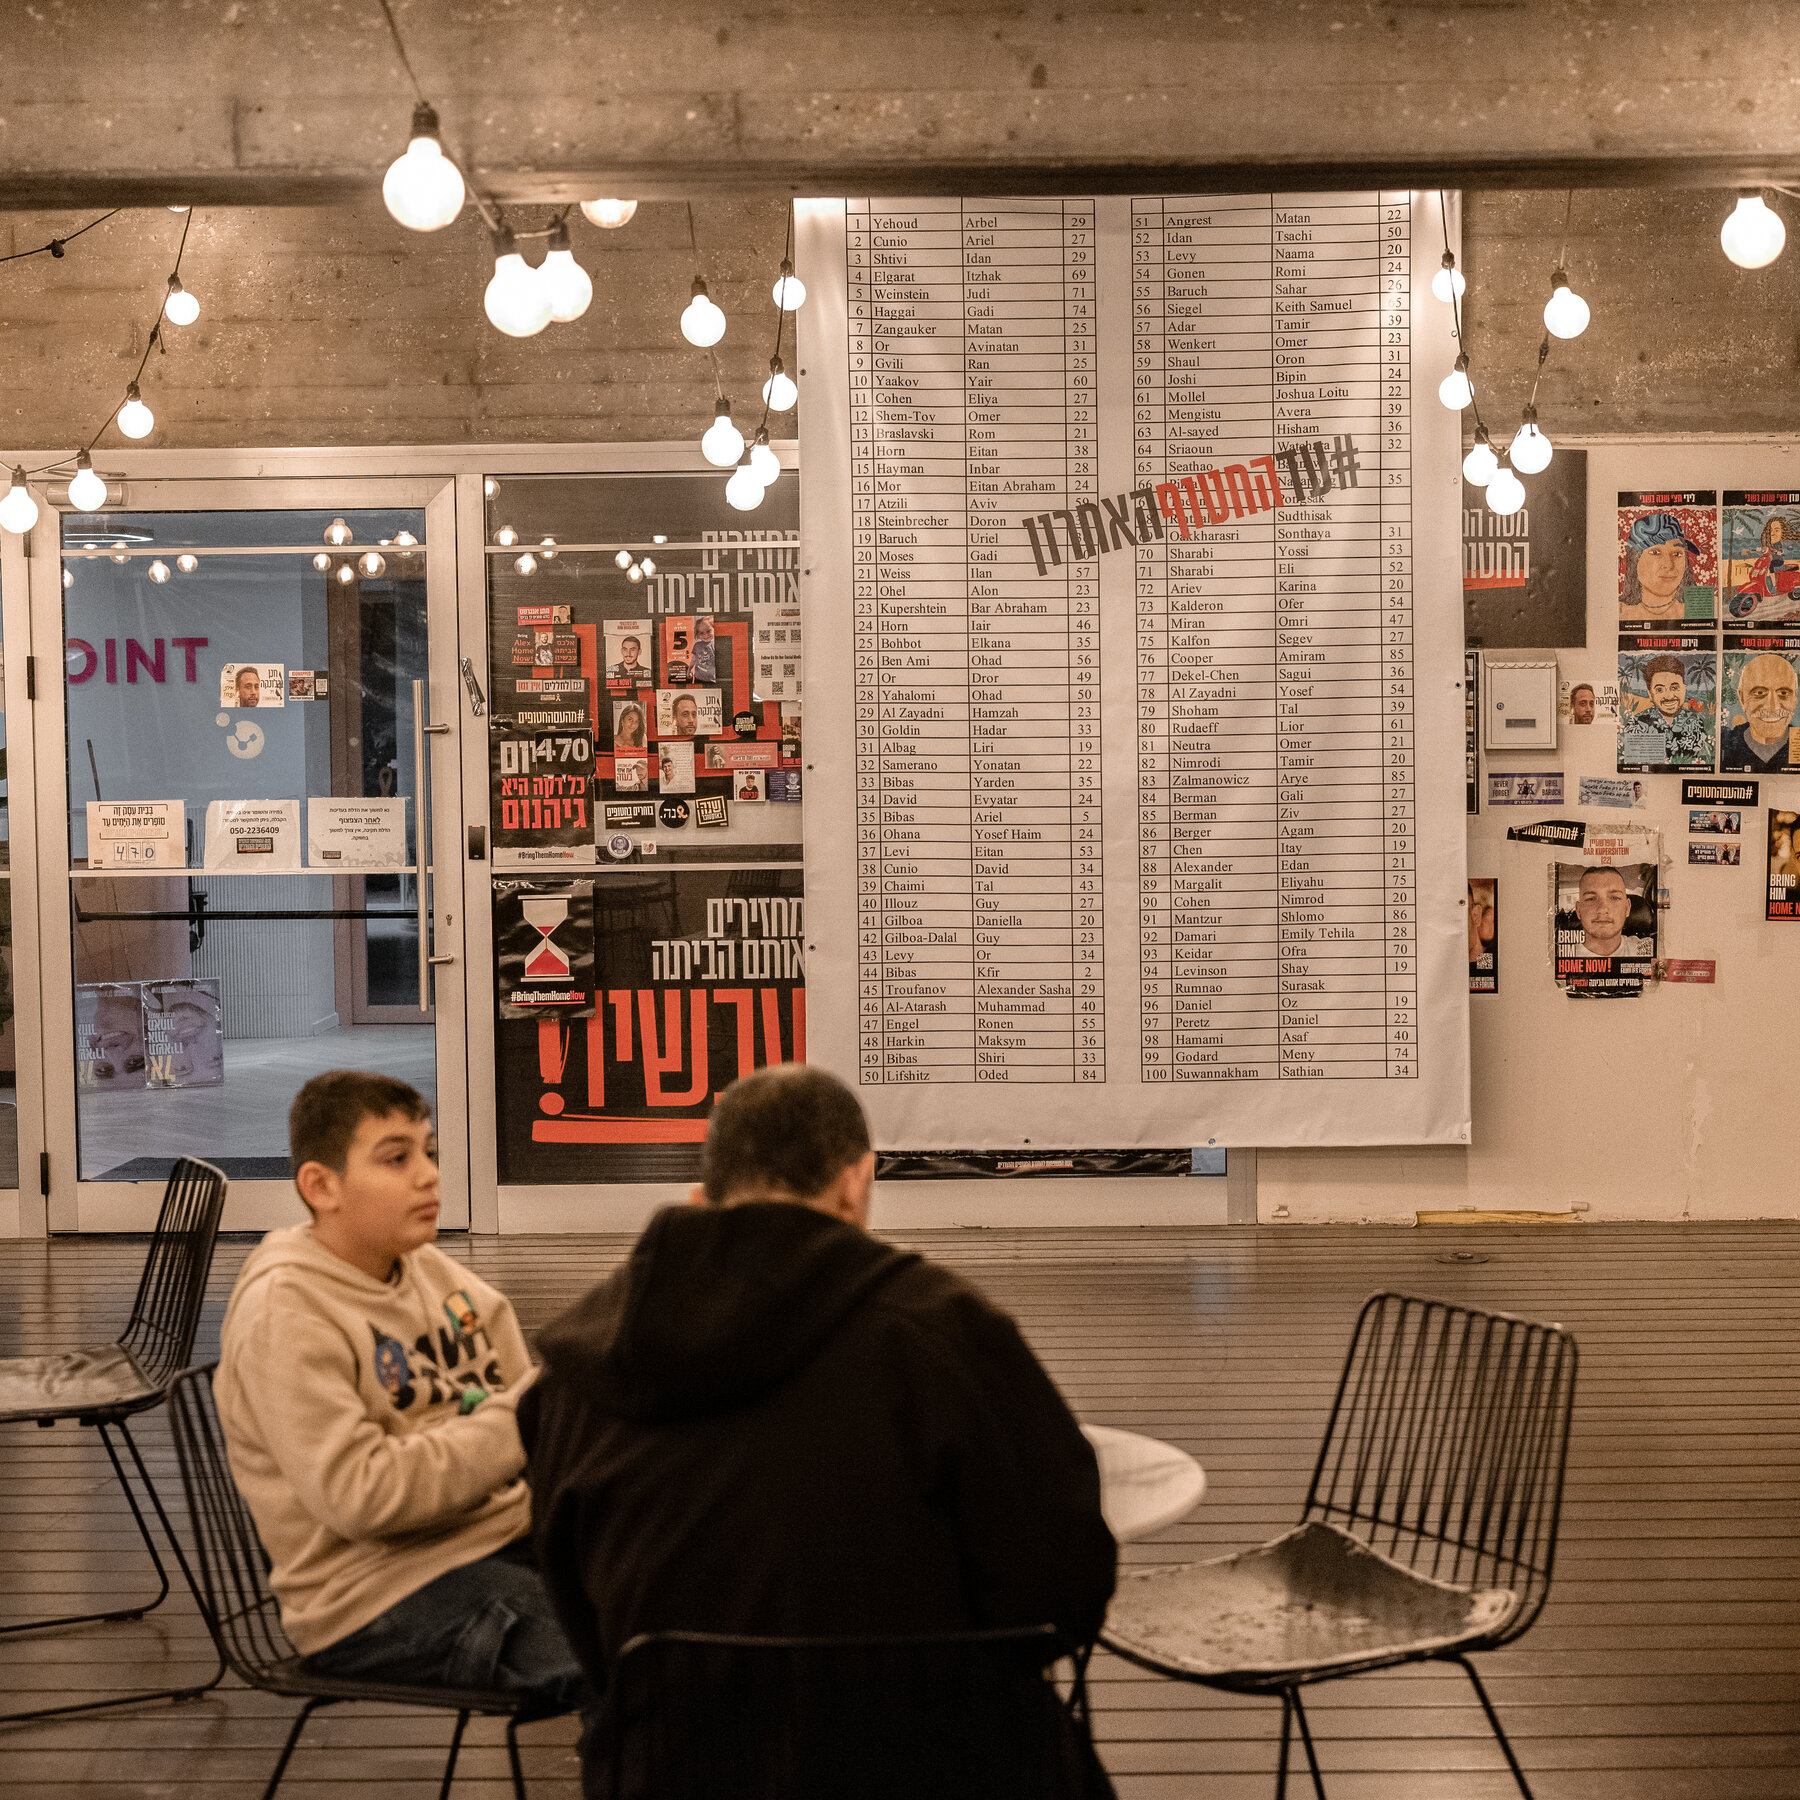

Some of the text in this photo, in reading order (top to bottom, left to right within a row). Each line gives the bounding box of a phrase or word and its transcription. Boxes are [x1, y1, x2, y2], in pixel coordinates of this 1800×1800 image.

[873, 218, 918, 229] Yehoud
[965, 217, 998, 228] Arbel
[1071, 217, 1086, 227] 29
[1135, 226, 1402, 244] 52 Idan Tsachi 50
[874, 341, 890, 351] Or
[967, 342, 1019, 352] Avinatan
[1073, 340, 1086, 351] 31
[1137, 385, 1402, 403] 61 Mollel Joshua Loitu 22
[858, 480, 1089, 492] 16 Mor Eitan Abraham 24
[1155, 455, 1286, 540] החטוף
[1656, 495, 1669, 503] שנה
[1022, 486, 1165, 577] האחרון
[647, 573, 731, 613] הביתה
[1139, 579, 1404, 594] 72 Ariev Karina 20
[673, 631, 688, 650] 5
[544, 681, 570, 690] לחללים
[860, 724, 1092, 736] 30 Goldin Hadar 33
[536, 738, 589, 762] 470
[1142, 771, 1405, 786] 83 Zalmanowicz Arye 85
[502, 776, 585, 798] כל דקה היא
[502, 799, 587, 829] גיהנום
[607, 806, 653, 817] בוחרים בחטופים
[1595, 847, 1629, 855] KUPERSHTEIN
[1770, 874, 1796, 887] BRING
[1770, 888, 1786, 900] HIM
[1769, 902, 1792, 914] HOME
[706, 898, 805, 938] מחזירים
[863, 932, 1094, 945] 42 Gilboa-Dalal Guy 23
[1143, 927, 1407, 942] 92 Damari Emily Tehila 28
[1558, 930, 1585, 943] BRING
[1558, 945, 1576, 957] HIM
[651, 940, 735, 980] הביתה
[1558, 959, 1584, 973] HOME
[1586, 958, 1611, 973] NOW!
[511, 990, 586, 1003] #BringThemHomeNow
[864, 1069, 1097, 1082] 50 Lifshitz Oded 84
[1147, 1065, 1409, 1080] 100 Suwannakham Sathian 34
